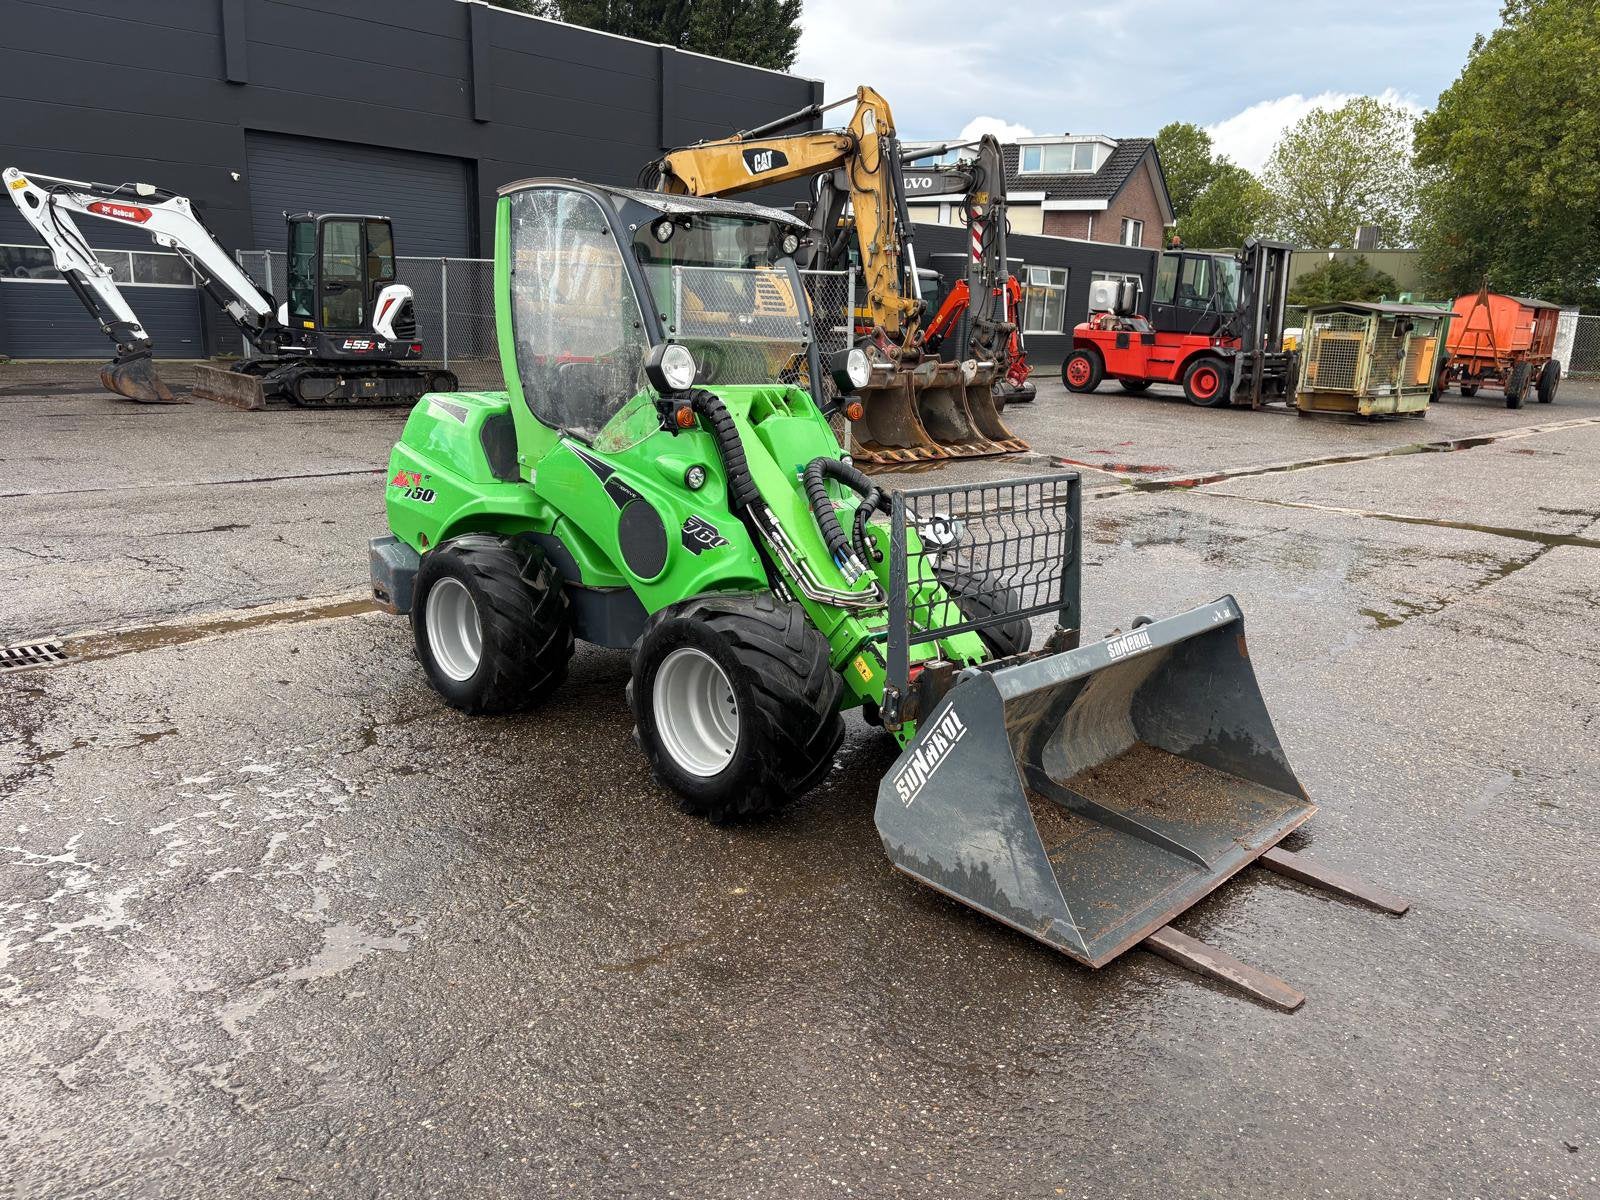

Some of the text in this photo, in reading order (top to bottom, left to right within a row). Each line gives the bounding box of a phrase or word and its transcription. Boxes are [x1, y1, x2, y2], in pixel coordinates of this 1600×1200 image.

[754, 150, 772, 172] CAT
[904, 177, 932, 189] LVO
[112, 208, 135, 218] Bobcat
